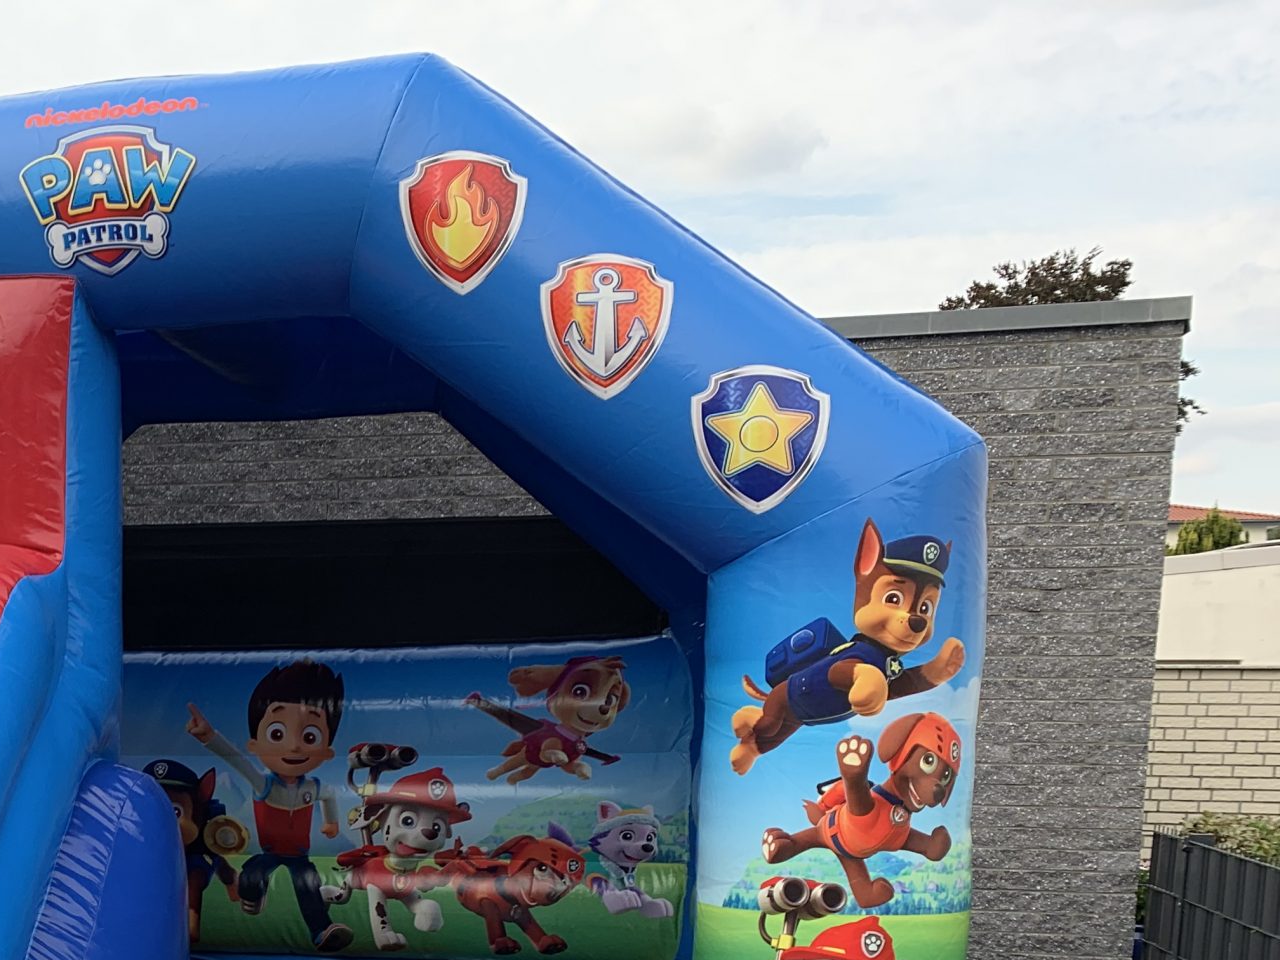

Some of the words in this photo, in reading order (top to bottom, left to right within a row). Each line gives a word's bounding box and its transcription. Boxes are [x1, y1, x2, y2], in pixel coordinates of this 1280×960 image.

[25, 97, 199, 128] nickelodeon
[19, 145, 197, 225] PAW
[62, 222, 154, 250] PATROL
